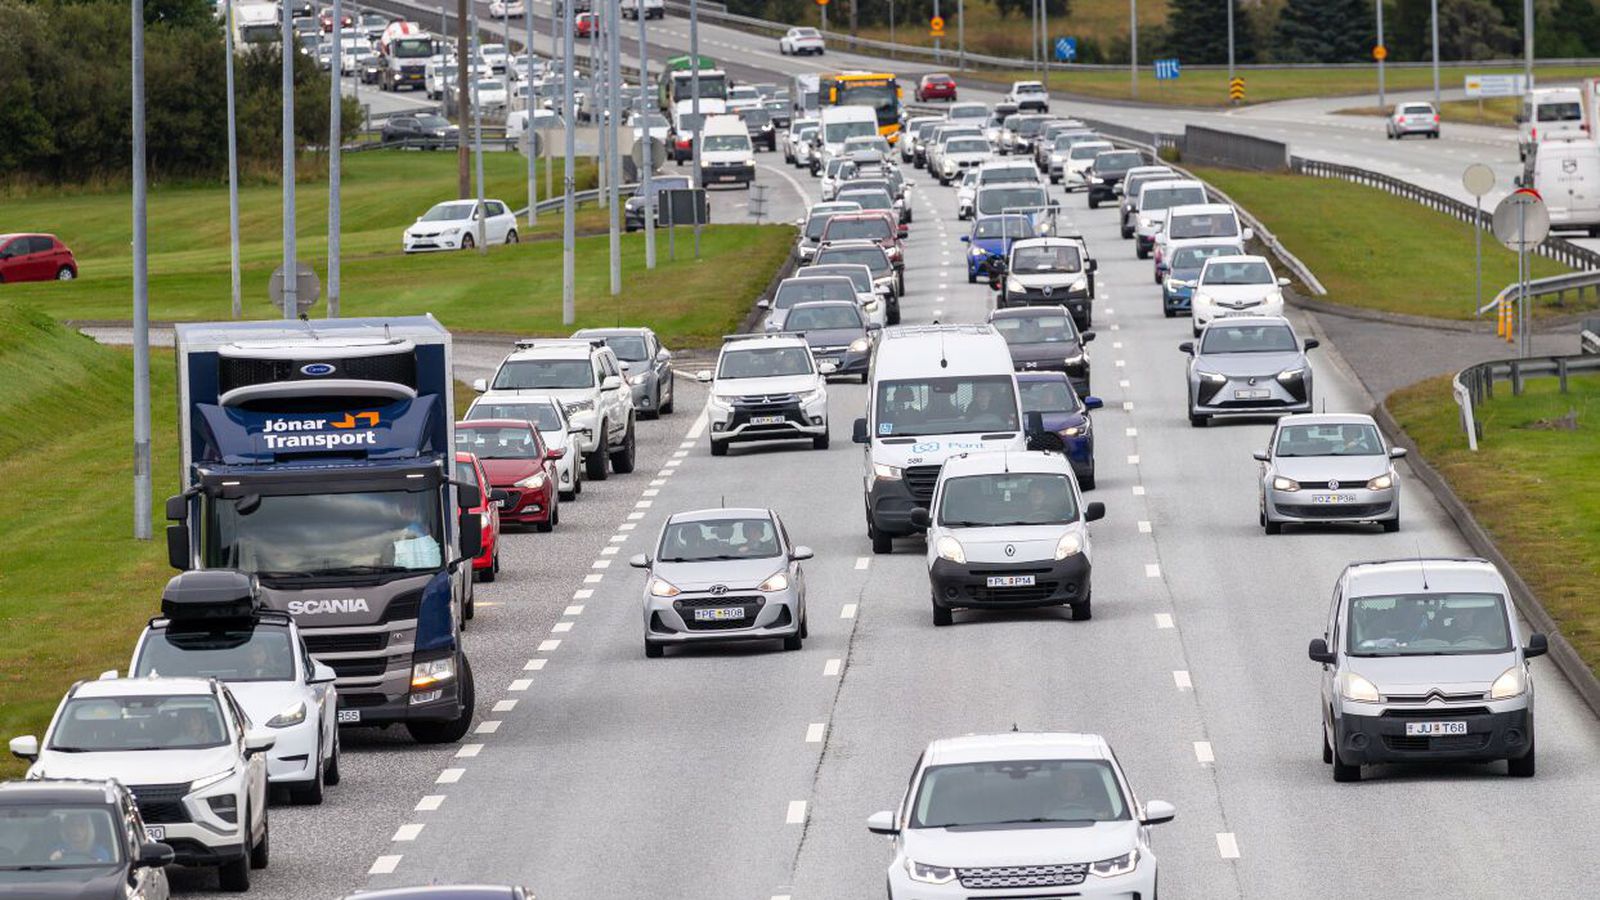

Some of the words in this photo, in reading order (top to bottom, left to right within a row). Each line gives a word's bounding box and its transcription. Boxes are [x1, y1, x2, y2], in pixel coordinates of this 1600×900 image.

[263, 418, 326, 432] Jónar
[263, 431, 376, 449] Transport
[287, 598, 370, 615] SCANIA
[702, 610, 716, 619] PE
[1417, 723, 1432, 733] JU
[1442, 722, 1465, 733] T68
